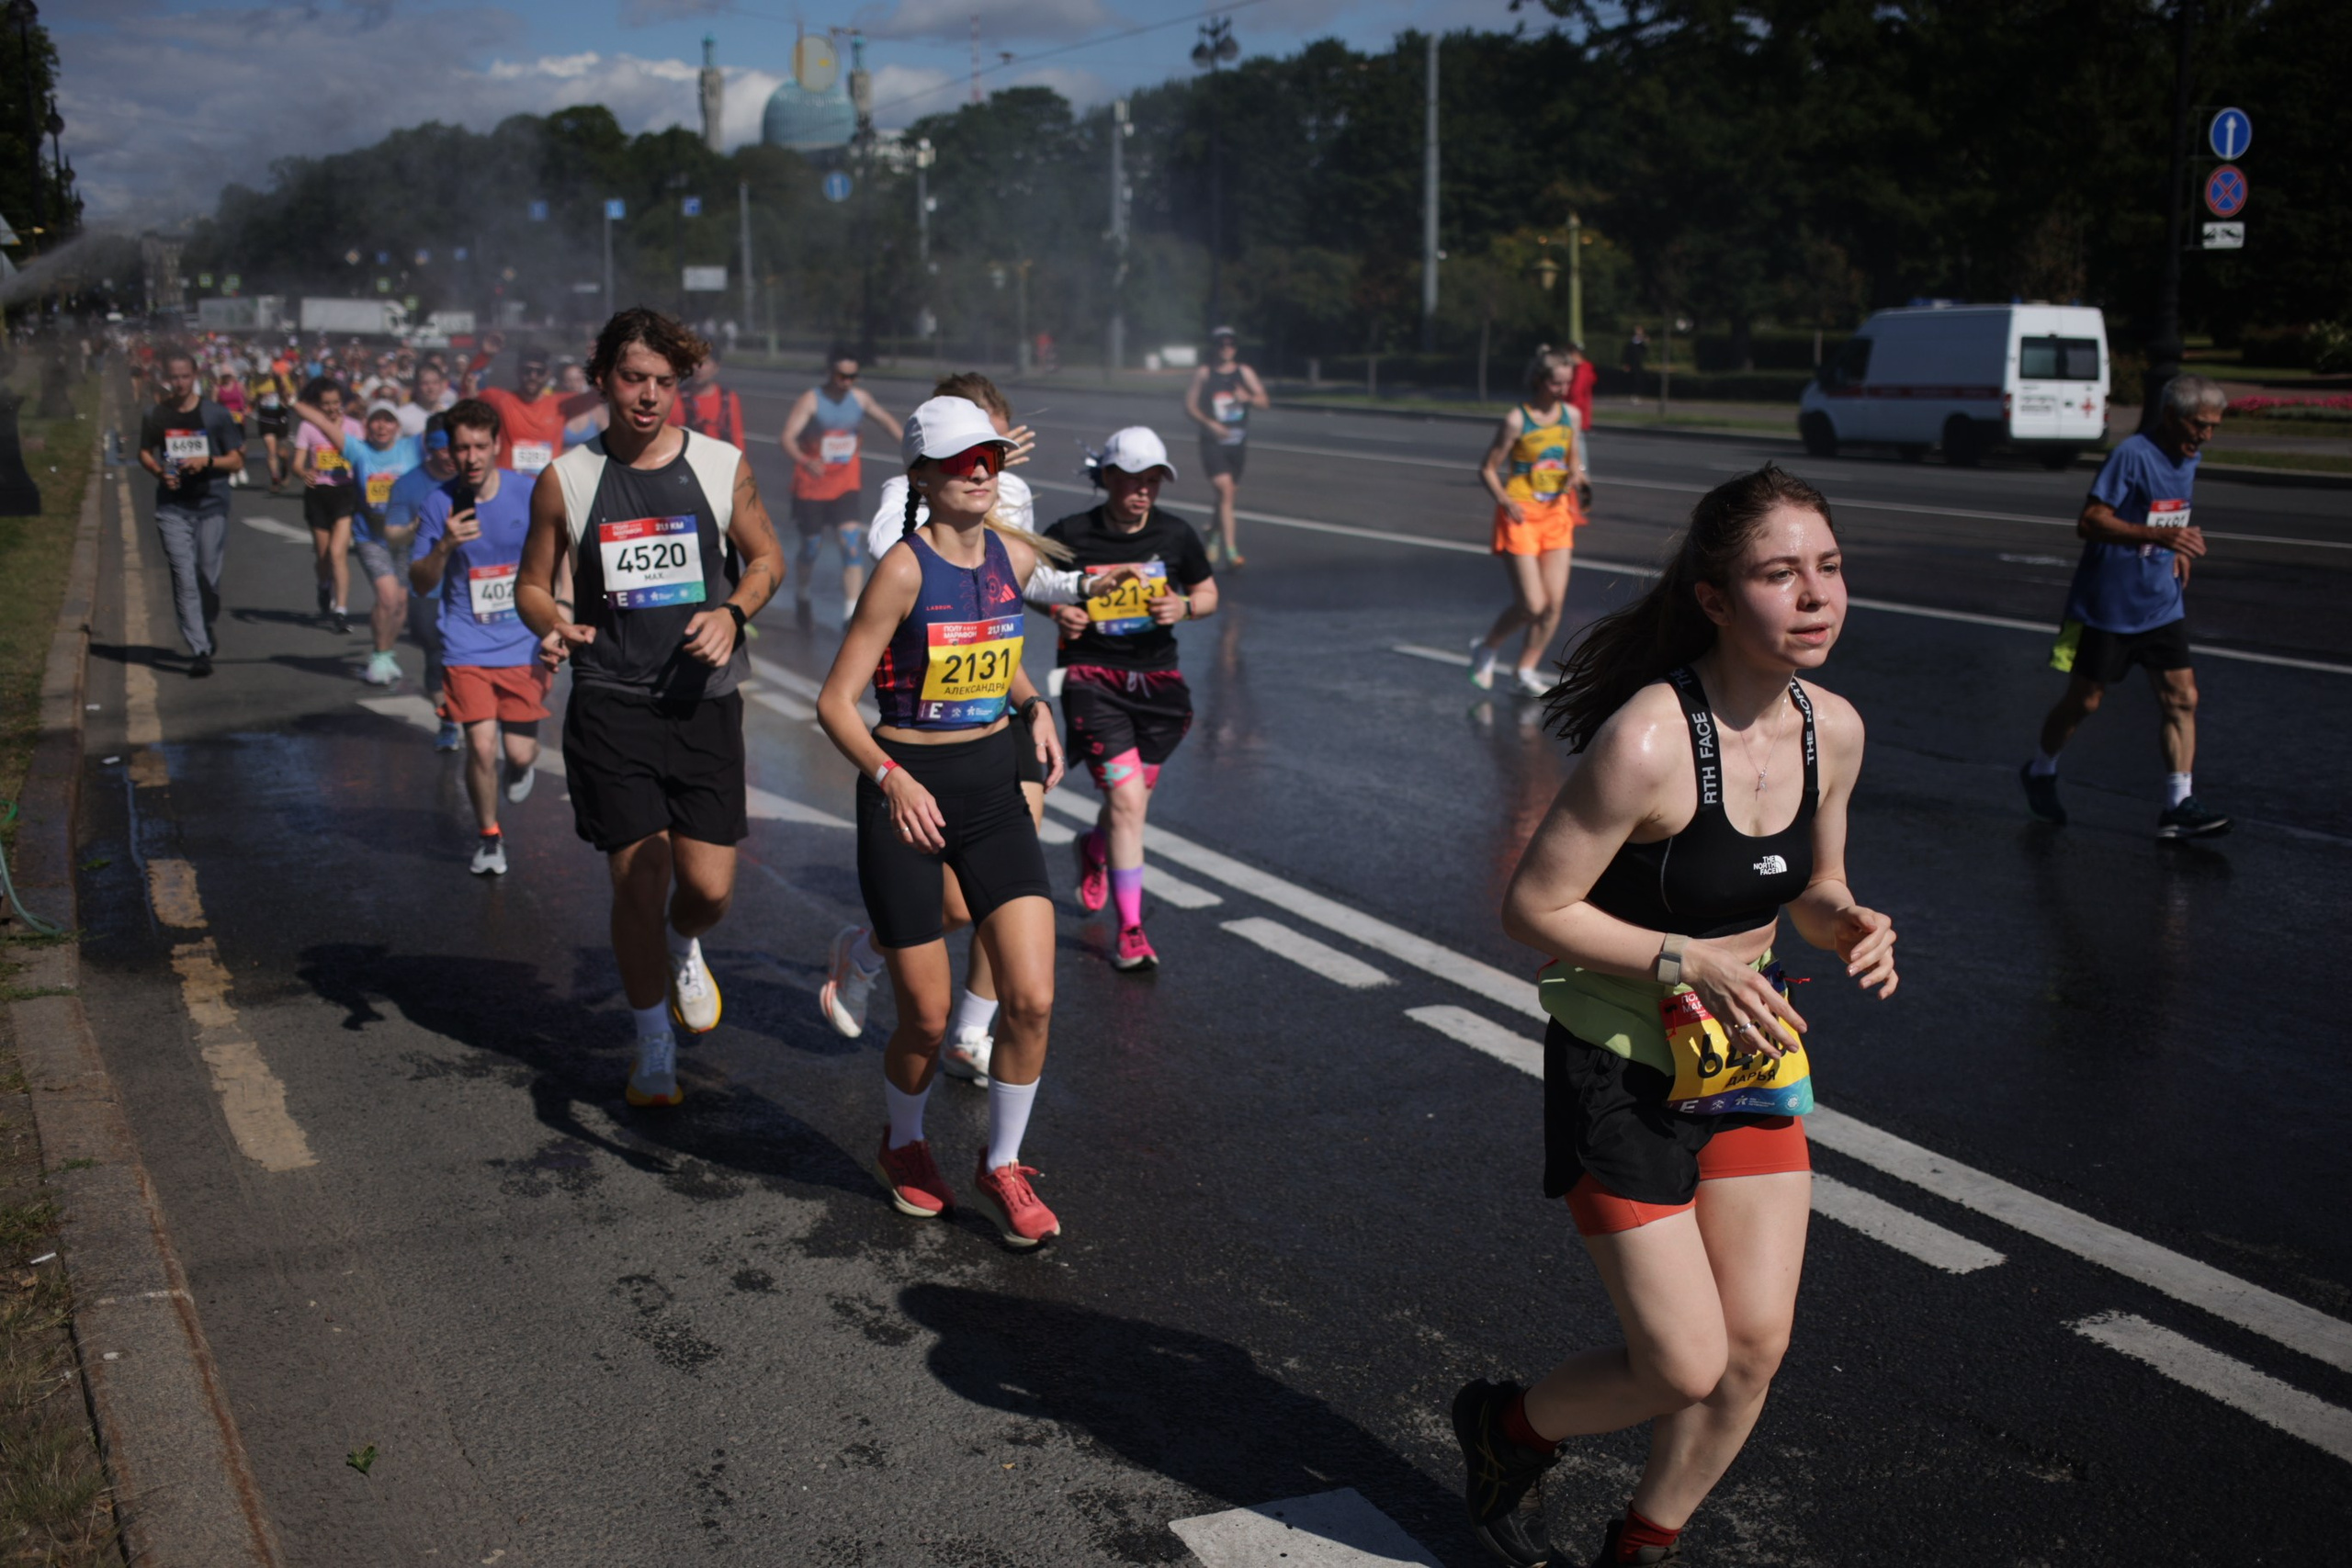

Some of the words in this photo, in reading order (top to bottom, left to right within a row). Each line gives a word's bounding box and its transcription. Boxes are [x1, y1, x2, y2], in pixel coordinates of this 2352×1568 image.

[616, 542, 686, 573] 4520
[941, 648, 1011, 684] 2131
[1691, 711, 1715, 759] FACE
[1806, 729, 1815, 766] THE
[1753, 862, 1776, 870] NORTH
[1762, 855, 1775, 863] THE
[1725, 1068, 1775, 1088] ДАРЬЯ
